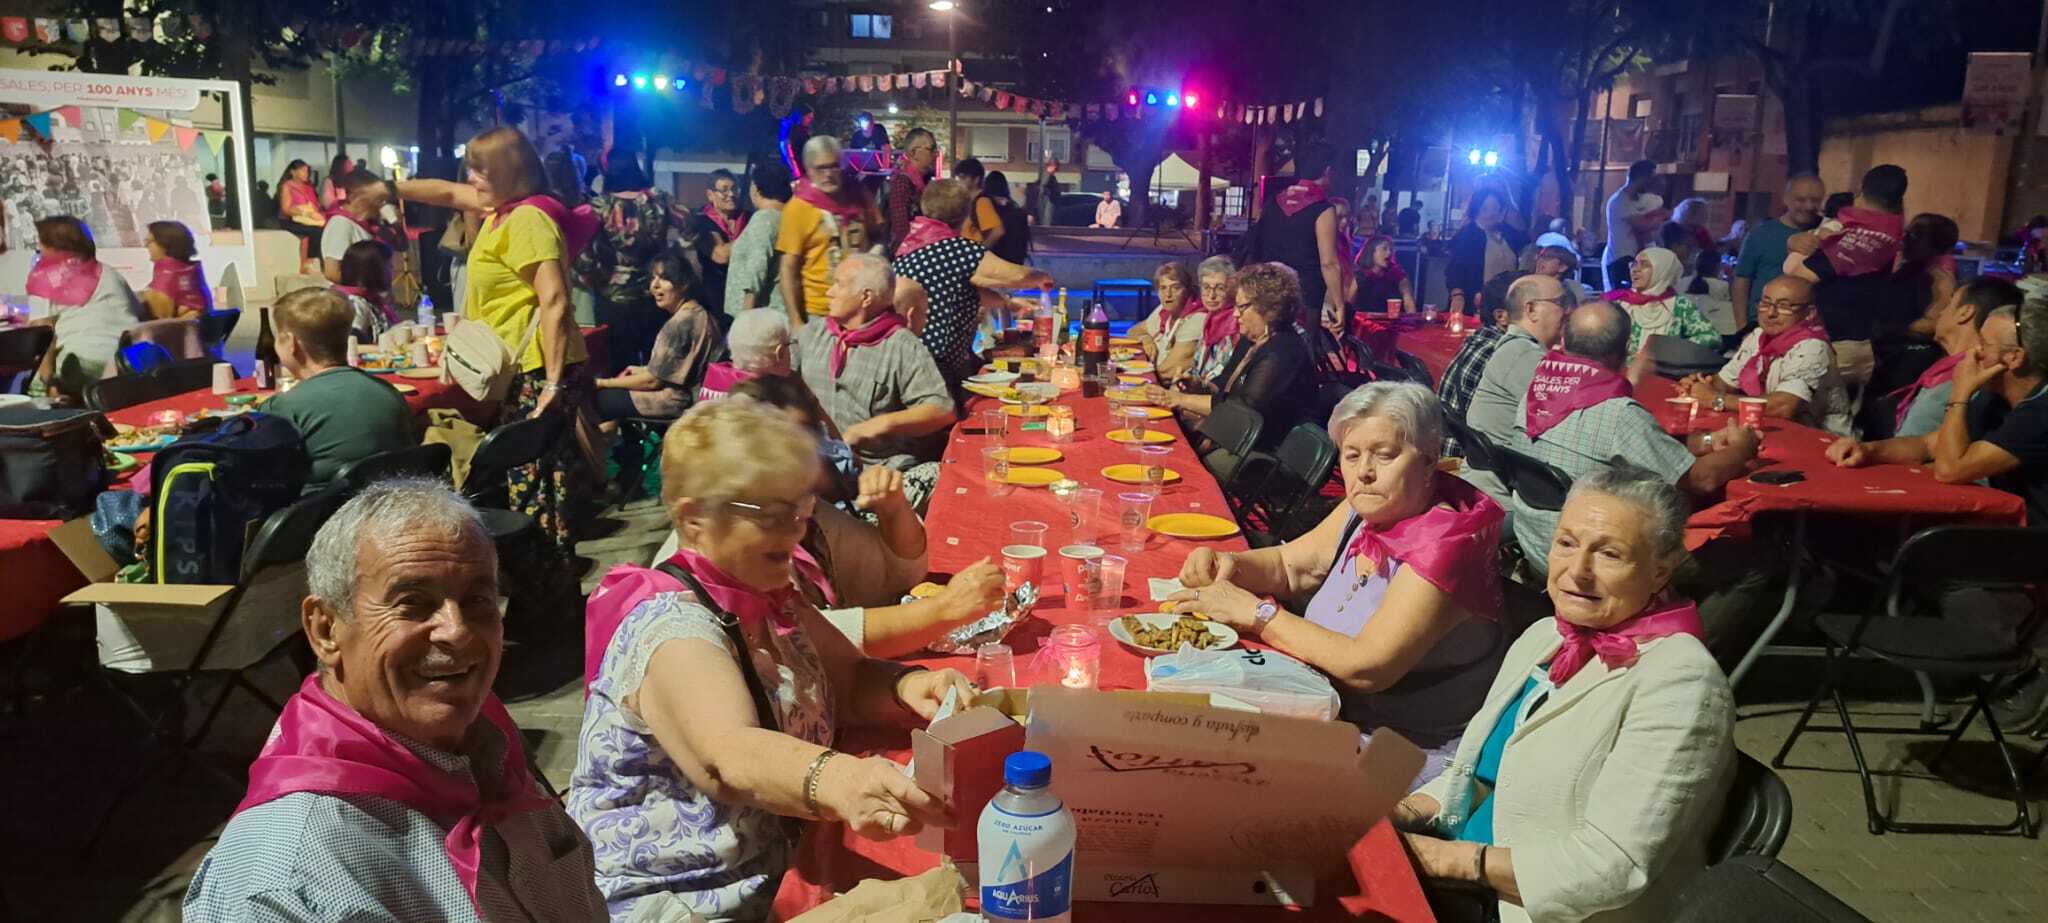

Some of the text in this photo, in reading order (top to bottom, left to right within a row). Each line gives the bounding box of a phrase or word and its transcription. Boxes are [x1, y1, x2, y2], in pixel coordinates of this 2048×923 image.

[87, 84, 112, 95] 100
[116, 86, 153, 97] ANYS
[1192, 714, 1203, 728] y
[1206, 719, 1261, 743] disfruta
[993, 819, 1011, 828] ZERO
